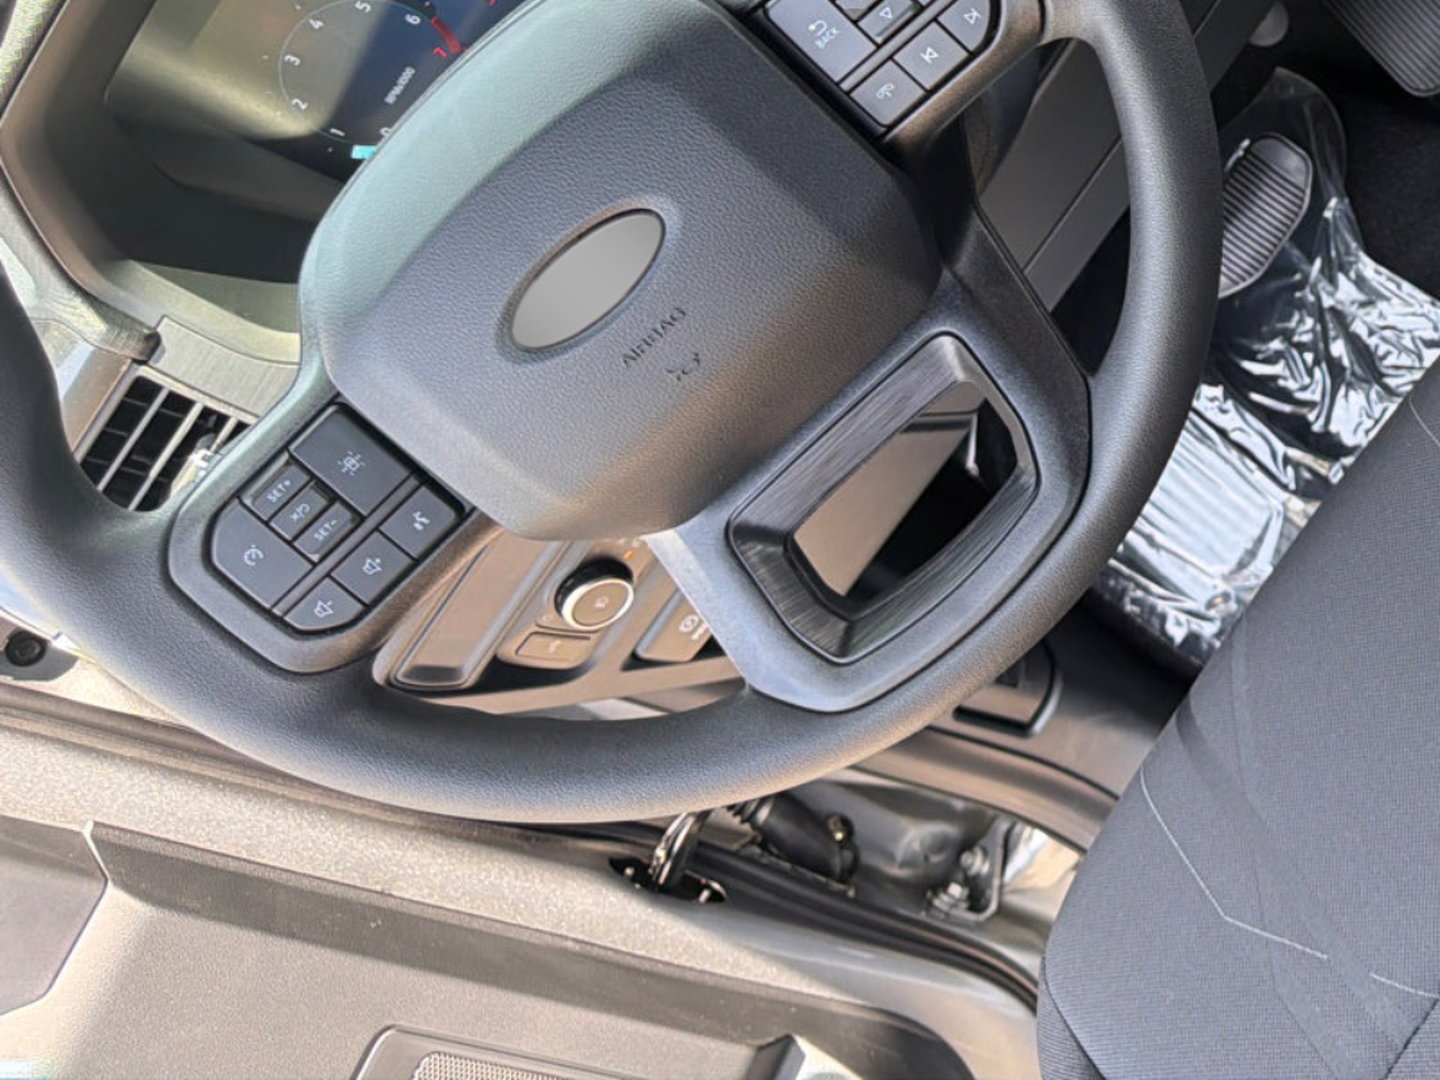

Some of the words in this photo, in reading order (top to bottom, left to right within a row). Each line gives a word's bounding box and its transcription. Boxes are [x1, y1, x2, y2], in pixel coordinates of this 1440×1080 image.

[354, 0, 371, 13] 5
[309, 19, 325, 30] 4
[405, 13, 421, 25] 6
[815, 26, 840, 49] BACK
[432, 47, 448, 59] 7
[284, 54, 301, 66] 3
[291, 98, 309, 110] 2
[329, 128, 346, 137] 1
